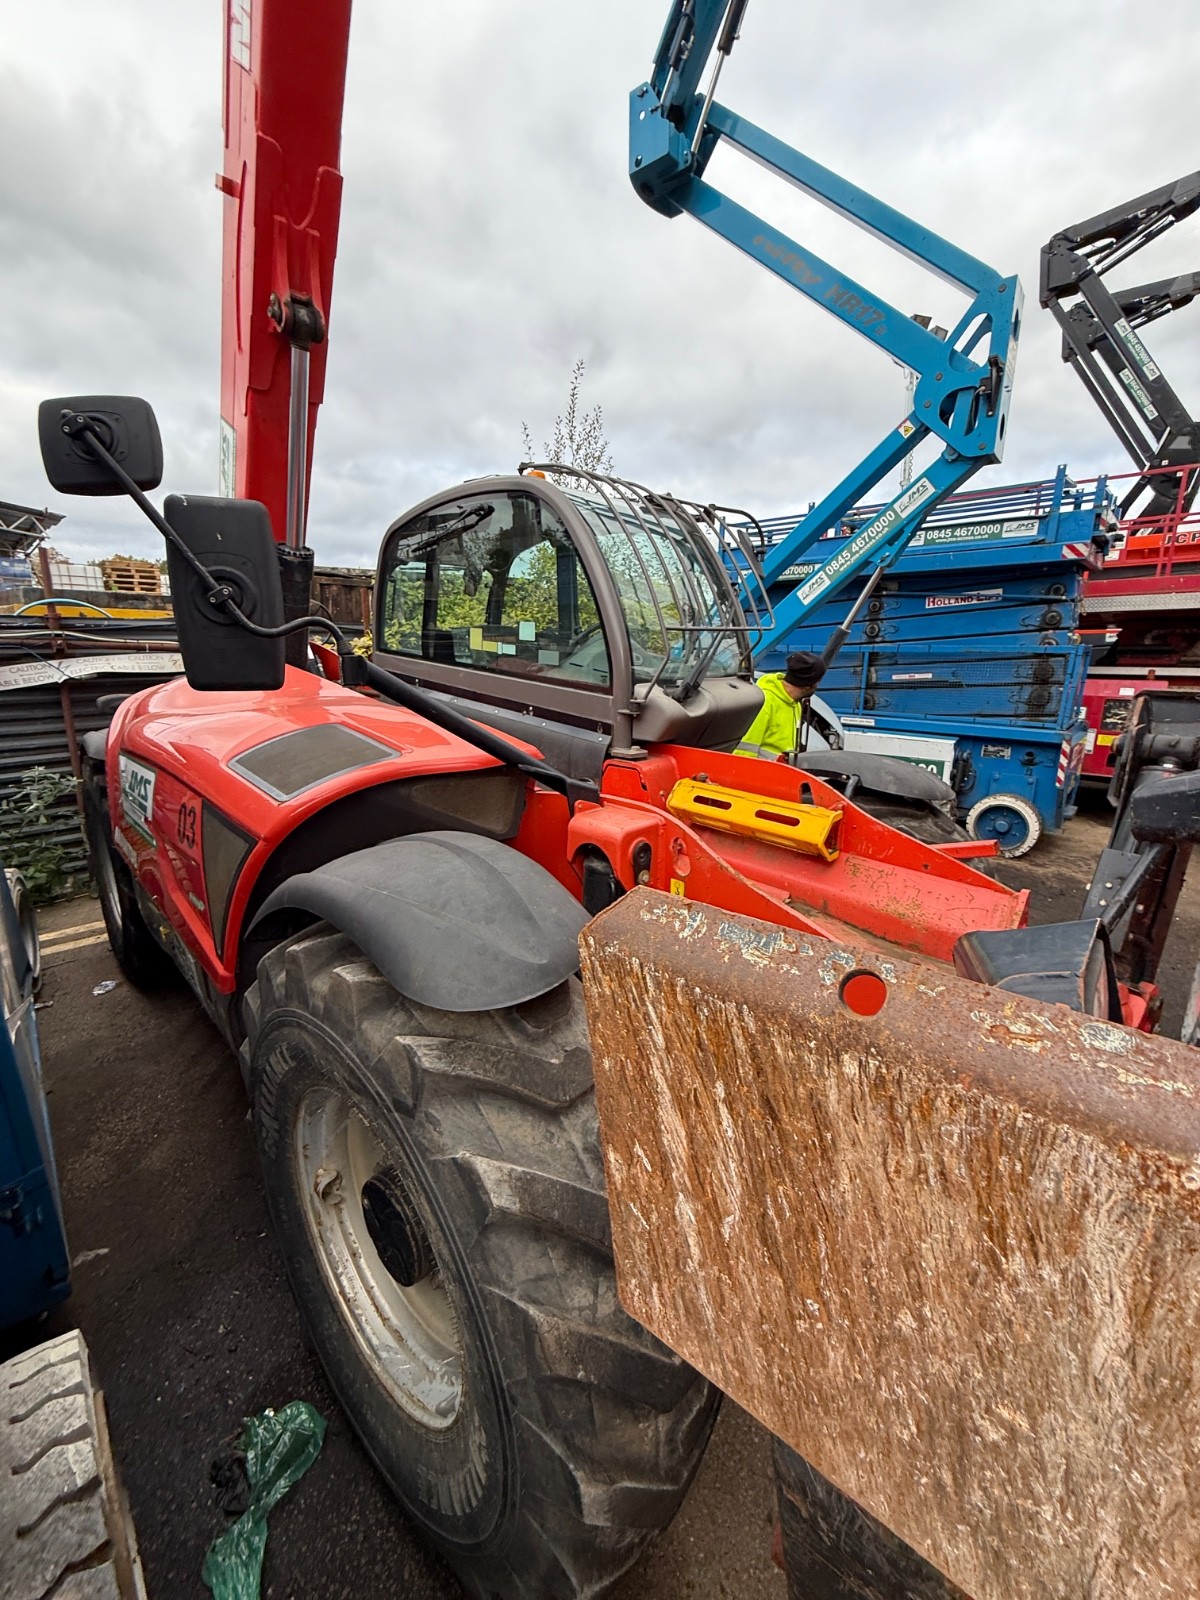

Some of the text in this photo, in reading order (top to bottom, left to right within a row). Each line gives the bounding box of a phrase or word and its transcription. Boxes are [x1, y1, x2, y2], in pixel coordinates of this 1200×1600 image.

[906, 480, 928, 503] JMS
[926, 529, 952, 540] 0845
[953, 523, 1001, 537] 4670000
[1015, 521, 1037, 529] JMS
[825, 510, 895, 576] 0845 4670000
[782, 565, 813, 575] 670000
[807, 573, 825, 592] JMS
[927, 595, 973, 607] HOLLAND
[9, 663, 51, 674] CAUTION
[23, 673, 54, 685] BELOW
[178, 801, 197, 850] 03
